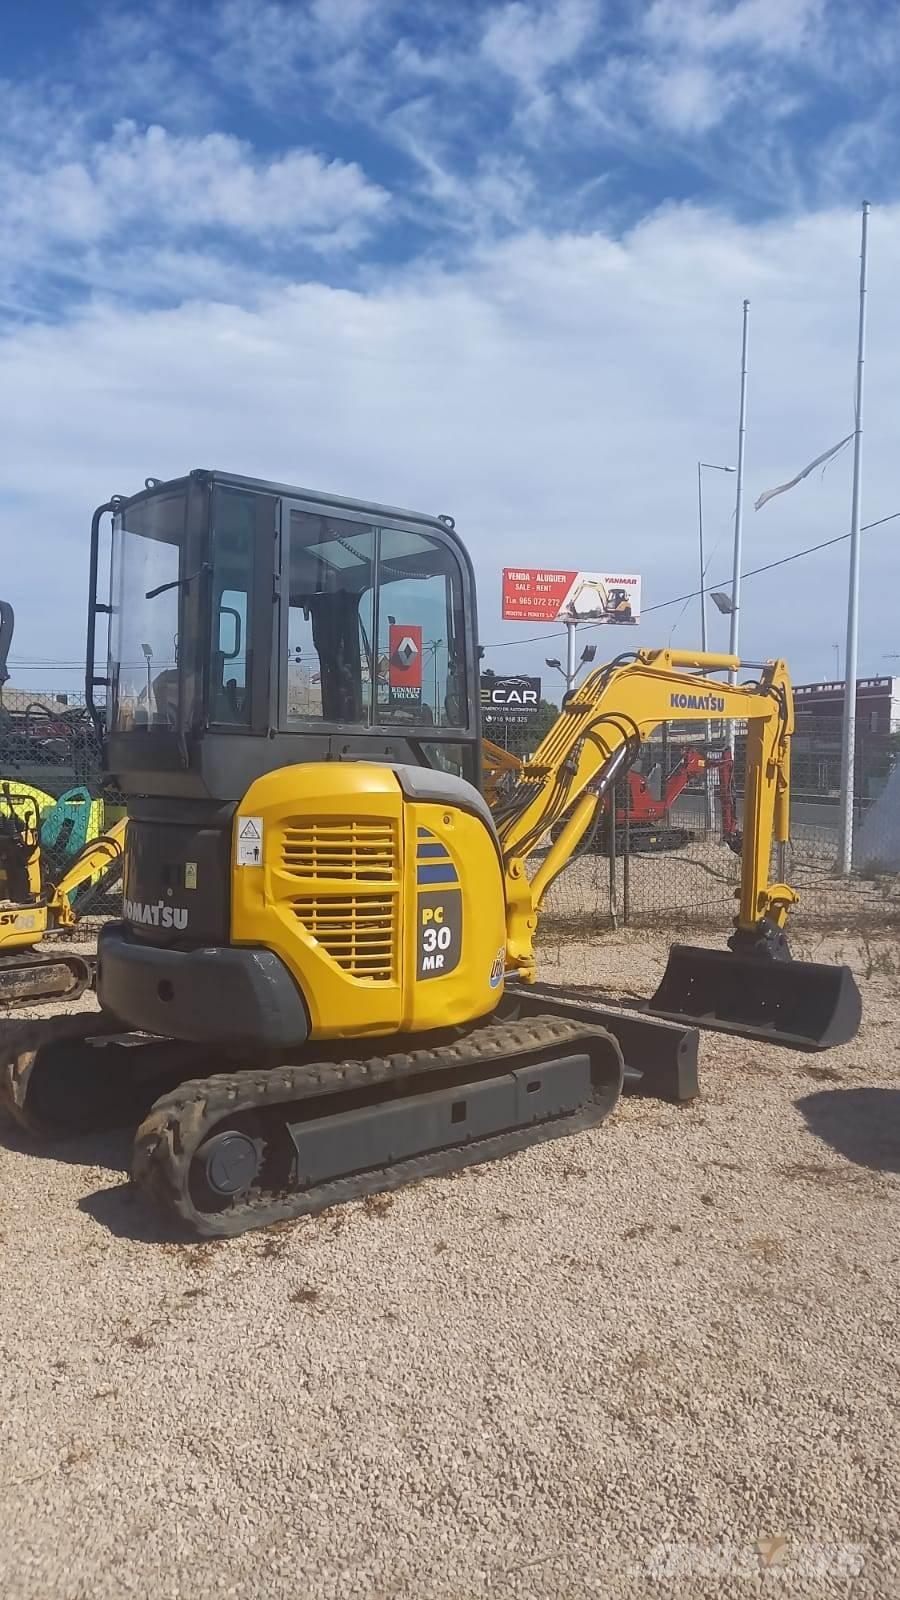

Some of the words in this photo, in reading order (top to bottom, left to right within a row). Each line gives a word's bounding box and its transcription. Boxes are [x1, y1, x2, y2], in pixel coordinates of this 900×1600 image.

[507, 572, 530, 581] VENDA
[536, 573, 567, 583] ALUGUER
[605, 577, 637, 585] YANMAR
[515, 583, 531, 591] SALE
[536, 584, 552, 592] RENT
[519, 596, 532, 605] 965
[533, 597, 547, 606] 072
[547, 598, 561, 607] 272
[670, 692, 725, 712] KOMATSU
[422, 906, 445, 926] PC
[422, 926, 451, 953] 30
[422, 954, 445, 972] MR
